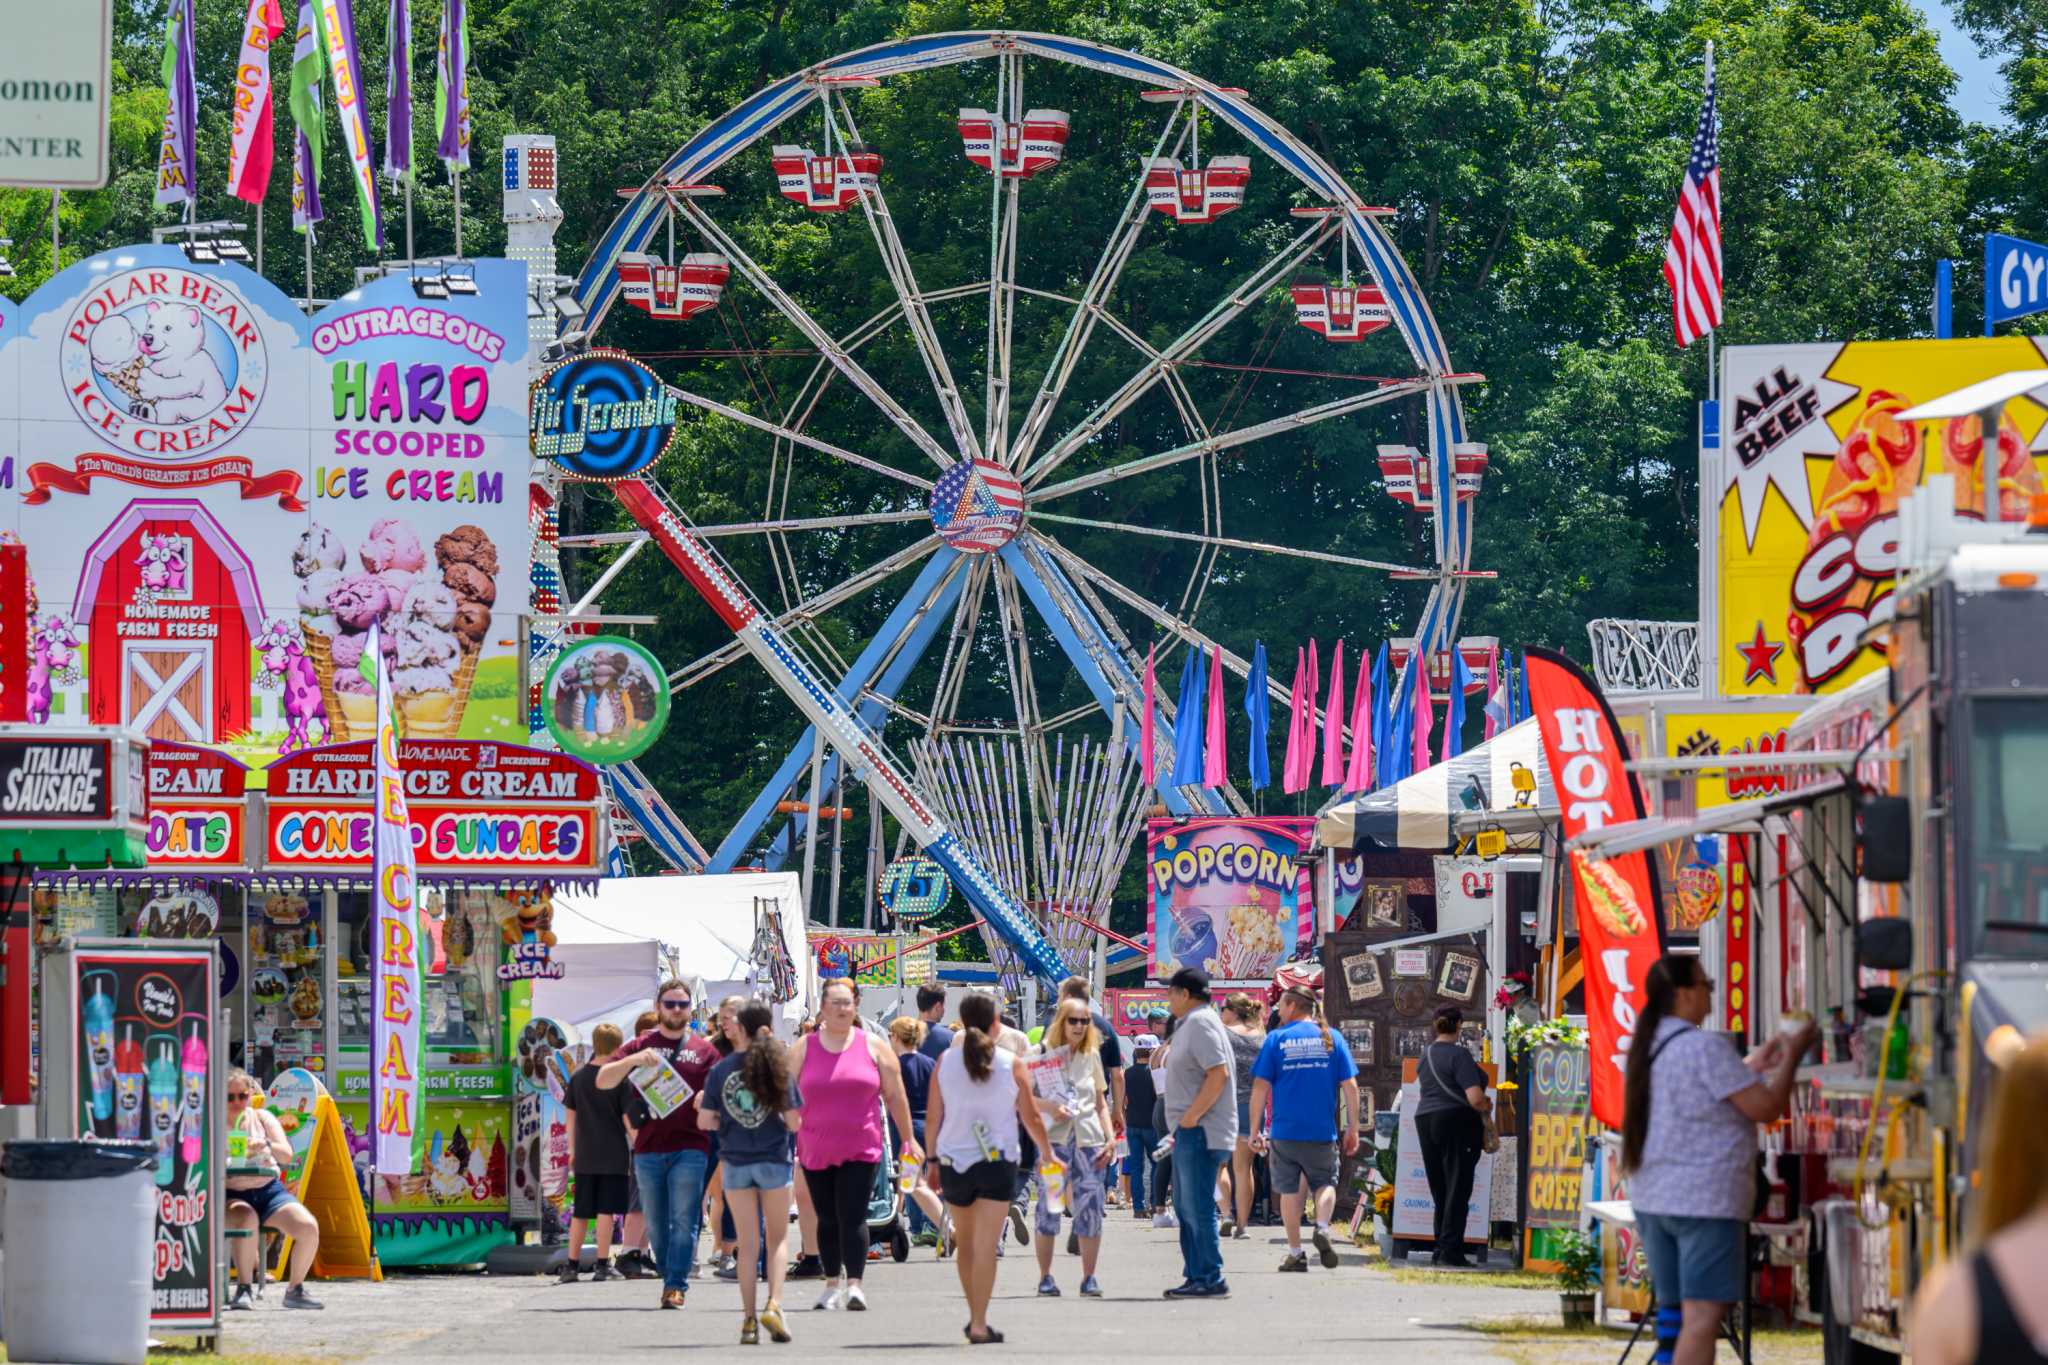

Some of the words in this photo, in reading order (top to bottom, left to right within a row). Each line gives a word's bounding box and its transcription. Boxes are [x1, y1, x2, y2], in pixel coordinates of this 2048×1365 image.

[0, 137, 83, 158] NTER
[2000, 248, 2048, 310] GY
[69, 272, 170, 346] POLAR
[179, 275, 258, 352] BEAR
[312, 305, 506, 363] OUTRAGEOUS
[331, 360, 489, 426] HARD
[1733, 365, 1803, 434] ALL
[72, 379, 126, 438] ICE
[133, 383, 258, 453] CREAM
[1734, 387, 1821, 470] BEEF
[335, 428, 485, 459] SCOOPED
[143, 469, 192, 484] GREATEST
[316, 466, 369, 499] ICE
[386, 467, 504, 504] CREAM
[117, 622, 160, 637] FARM
[166, 623, 219, 638] FRESH
[124, 604, 211, 620] HOMEMADE
[22, 747, 94, 775] ITALIAN
[312, 754, 369, 763] OUTRAGEOUS!
[398, 746, 472, 762] HOMEMADE
[1554, 707, 1614, 833] HOT
[2, 767, 103, 813] SAUSAGE
[150, 767, 225, 794] EAM
[286, 768, 376, 794] HARD
[460, 772, 578, 797] CREAM
[280, 816, 376, 853] CONE
[435, 818, 578, 856] SUNDAES
[1152, 842, 1300, 896] POPCORN
[1731, 861, 1745, 939] HOT
[497, 960, 565, 979] CREAM
[511, 943, 547, 958] ICE
[424, 1075, 449, 1089] ARM
[454, 1075, 494, 1089] FRESH
[156, 1188, 207, 1225] enir
[1528, 1172, 1582, 1212] COFF
[154, 1240, 184, 1281] ps
